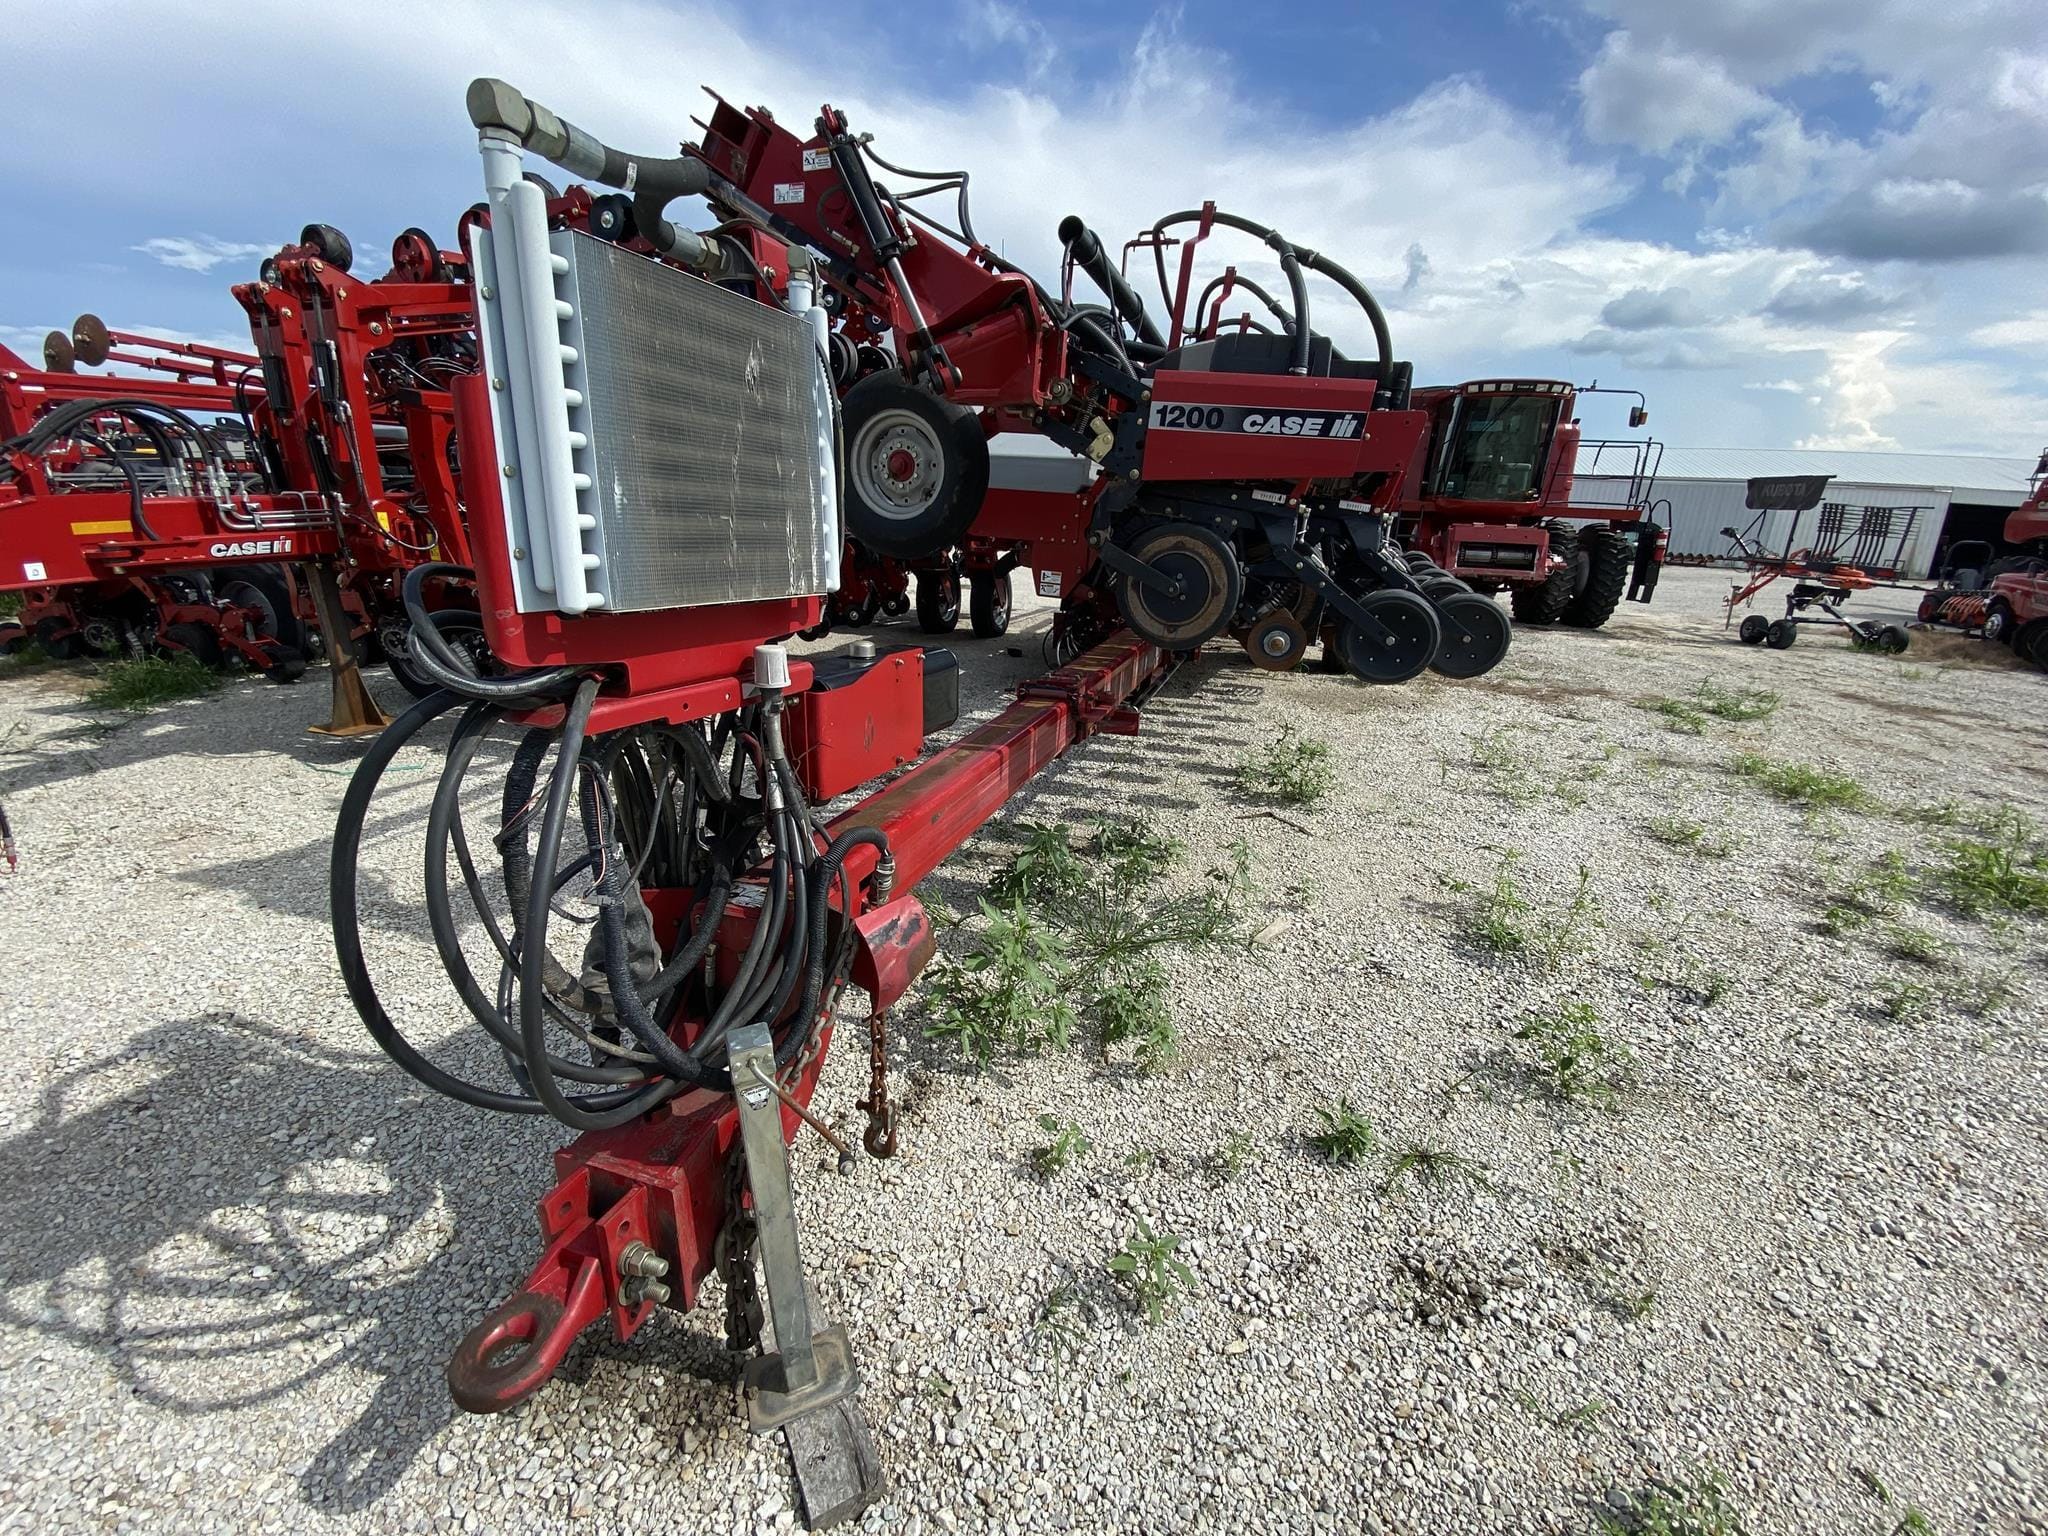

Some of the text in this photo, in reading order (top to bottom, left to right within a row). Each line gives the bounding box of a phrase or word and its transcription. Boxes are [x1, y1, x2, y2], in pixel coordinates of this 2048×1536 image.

[1156, 405, 1224, 429] 1200
[1242, 415, 1325, 436] CASE
[210, 541, 271, 557] CASE
